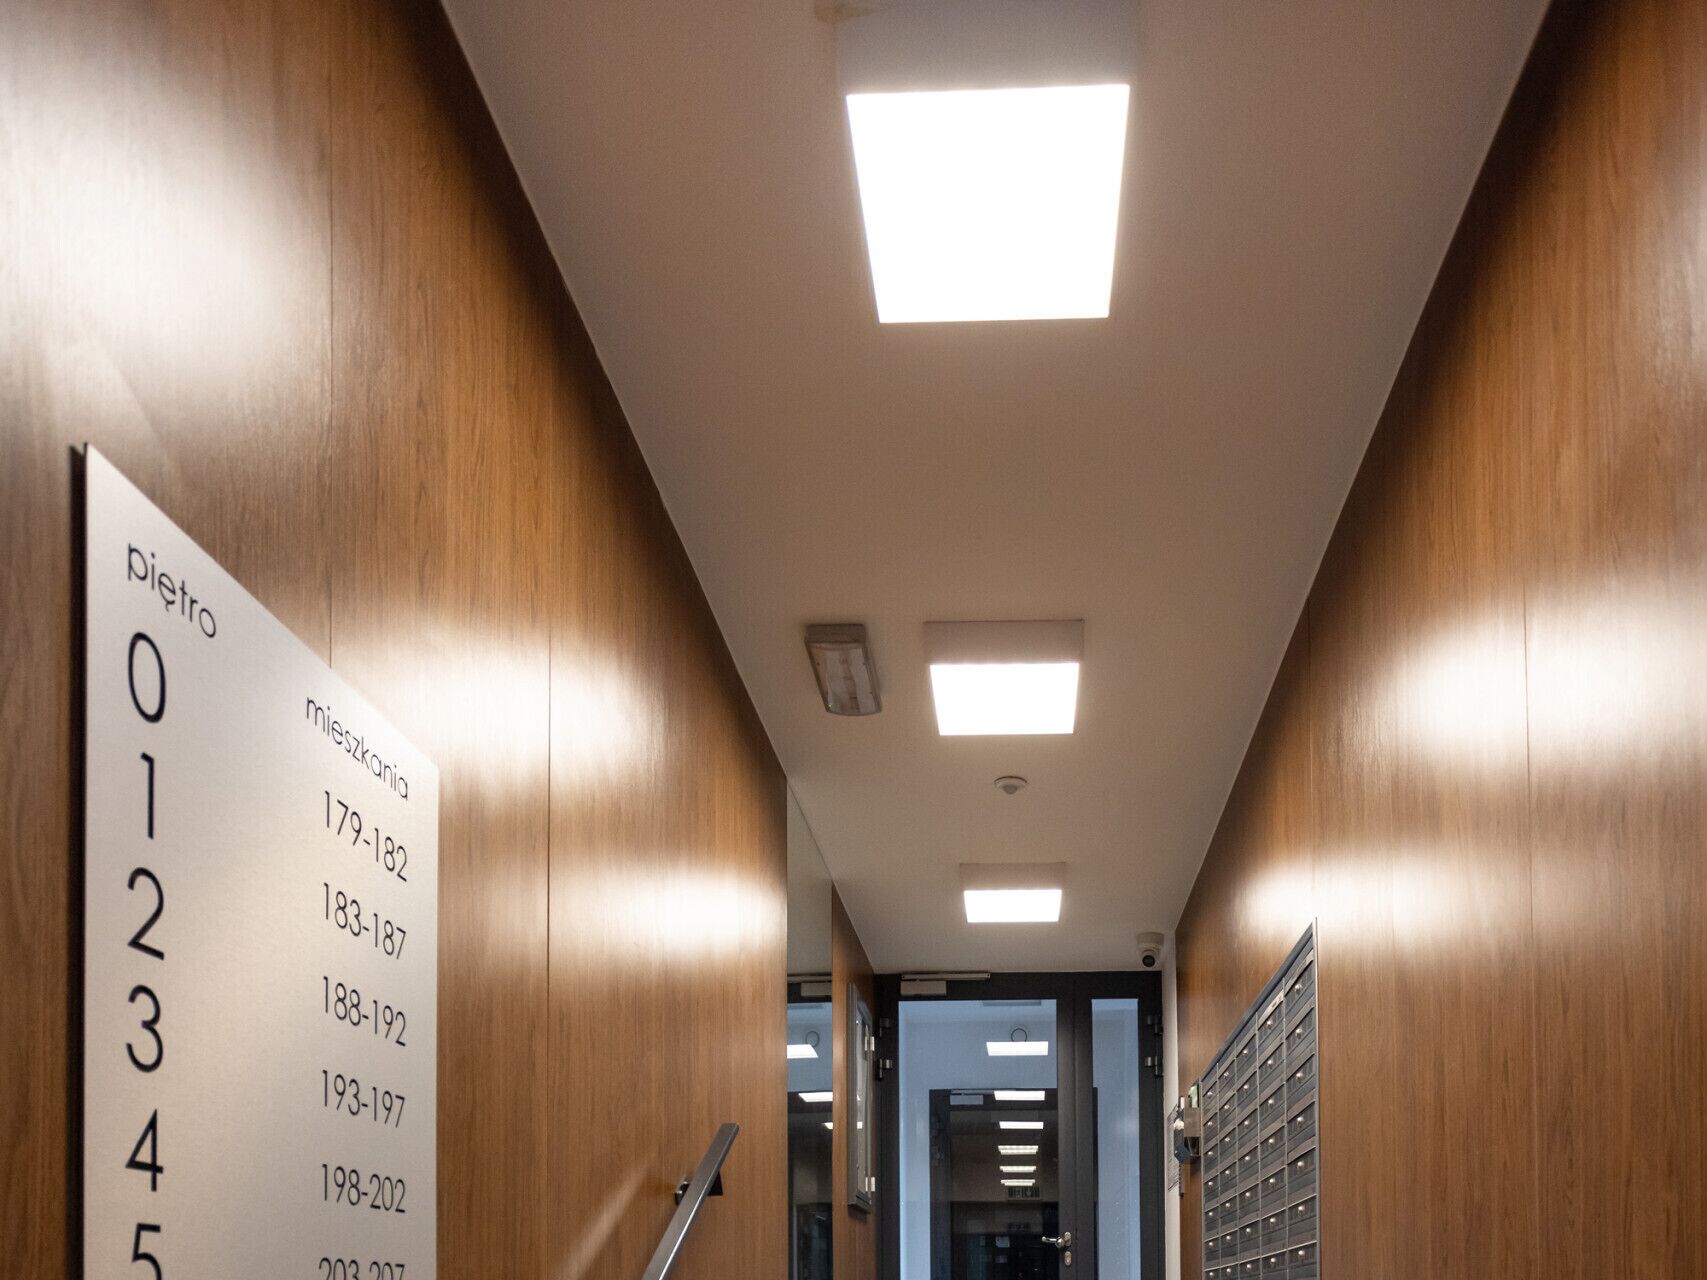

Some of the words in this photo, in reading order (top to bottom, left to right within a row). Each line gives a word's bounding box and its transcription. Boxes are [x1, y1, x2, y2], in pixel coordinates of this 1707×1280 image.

[127, 542, 217, 639] piętro
[128, 631, 166, 724] 0
[306, 695, 409, 801] mieszkania
[140, 751, 155, 841] 1
[324, 790, 408, 883] 179-182
[126, 866, 165, 962] 2
[323, 882, 407, 960] 183-187
[125, 983, 164, 1074] 3
[322, 975, 407, 1048] 188-192
[321, 1069, 406, 1129] 193-197
[124, 1108, 165, 1193] 4
[321, 1163, 406, 1214] 198-202
